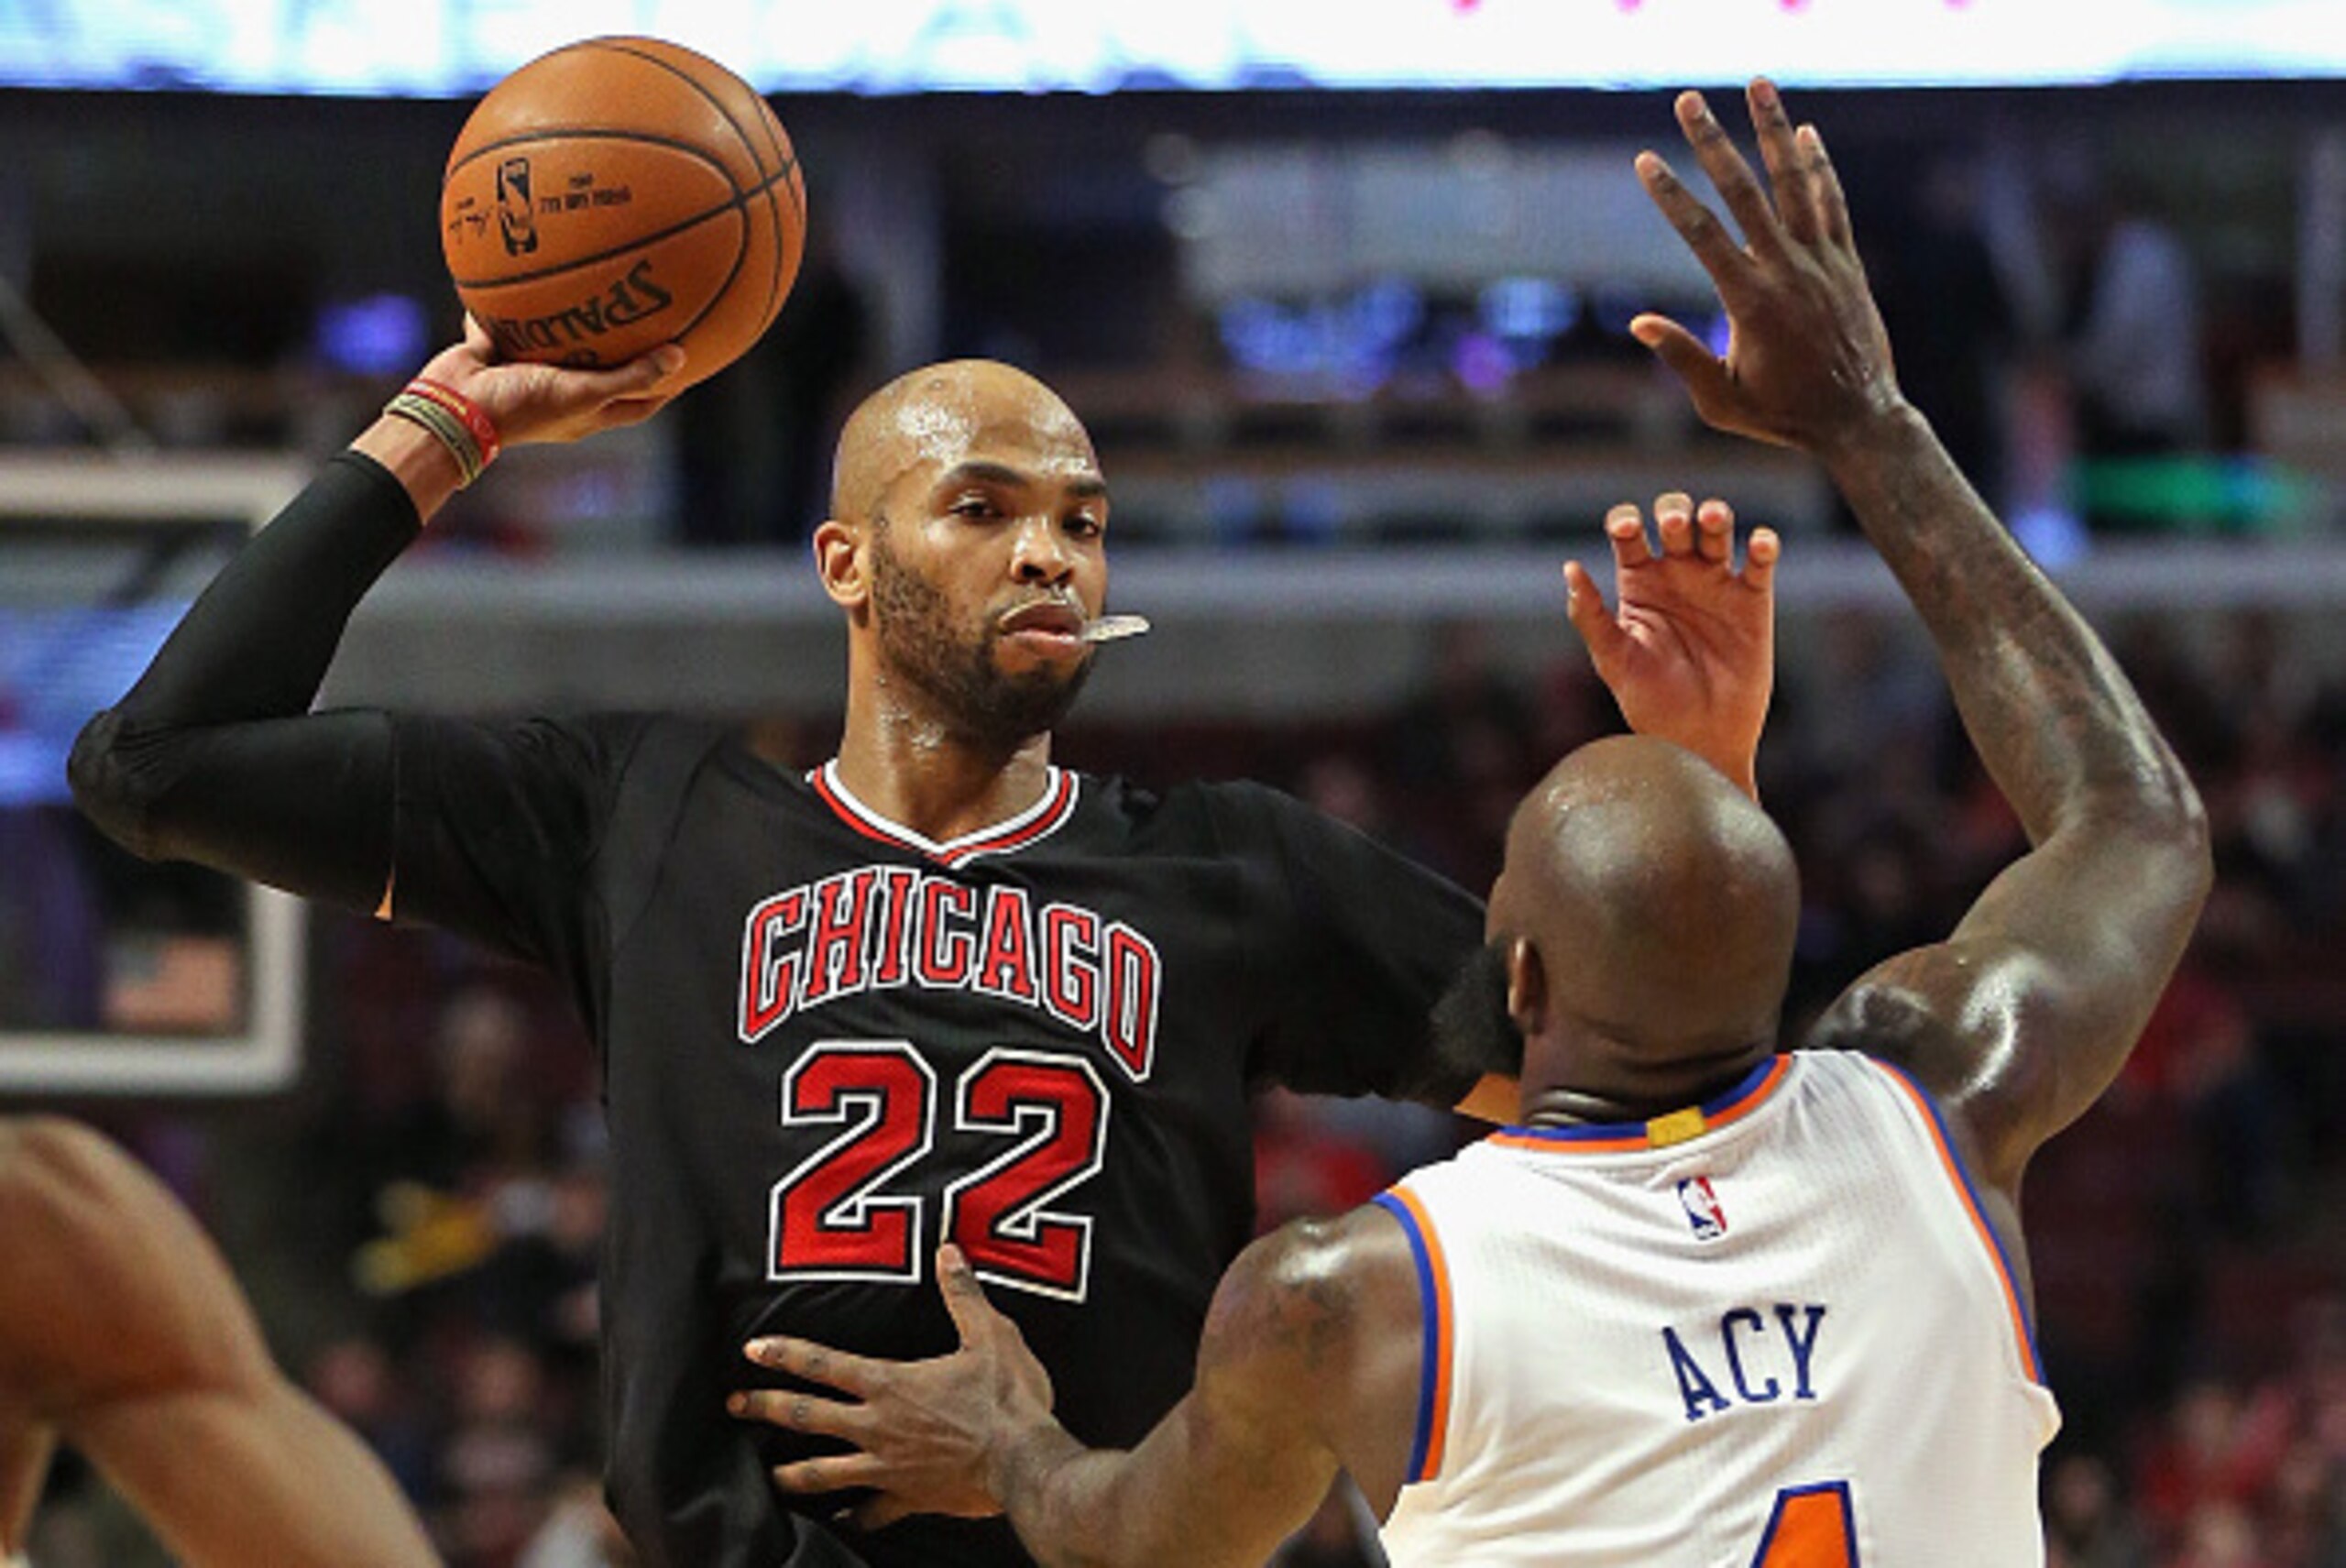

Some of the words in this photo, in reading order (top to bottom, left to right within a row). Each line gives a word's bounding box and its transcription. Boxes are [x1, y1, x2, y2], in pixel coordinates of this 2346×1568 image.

[738, 865, 1161, 1082] CHICAGO
[768, 1040, 1110, 1303] 22
[1662, 1303, 1825, 1421] ACY
